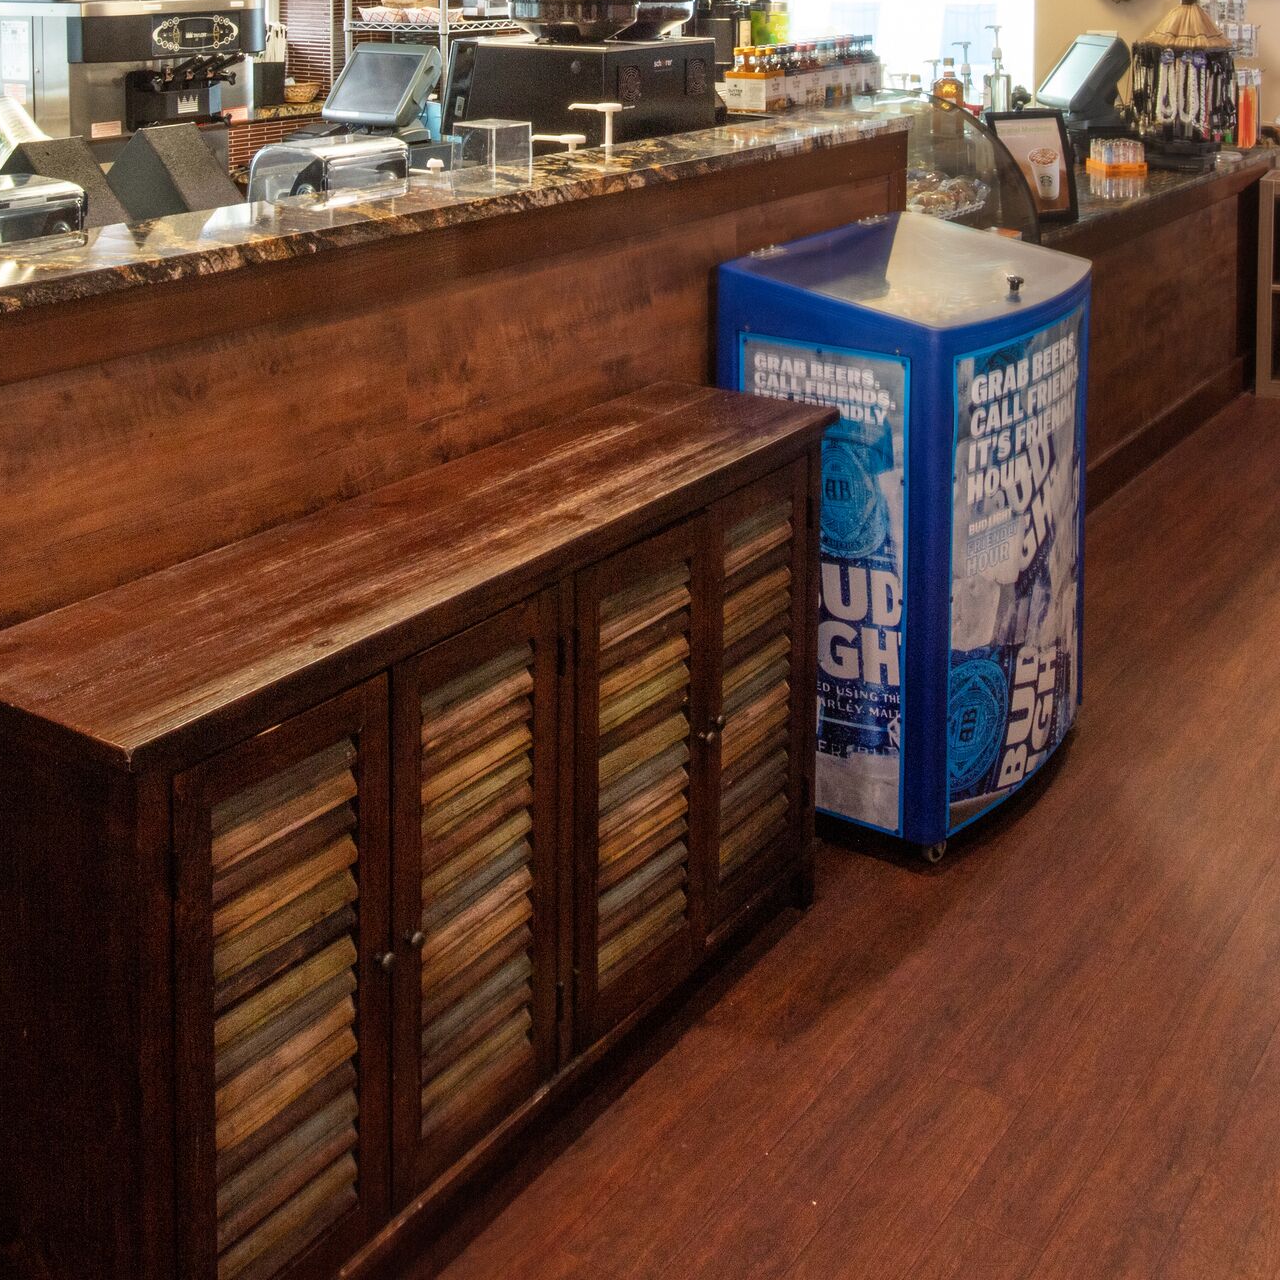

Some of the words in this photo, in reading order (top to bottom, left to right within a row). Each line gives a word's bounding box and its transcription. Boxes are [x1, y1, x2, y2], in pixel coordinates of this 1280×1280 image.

[754, 351, 807, 379] GRAB
[972, 358, 1030, 405] GRAB
[753, 371, 802, 395] CALL
[970, 392, 1025, 440] CALL
[968, 428, 1011, 471] IT'S
[968, 517, 987, 536] BUD
[836, 685, 878, 703] USING
[997, 645, 1040, 789] BUD
